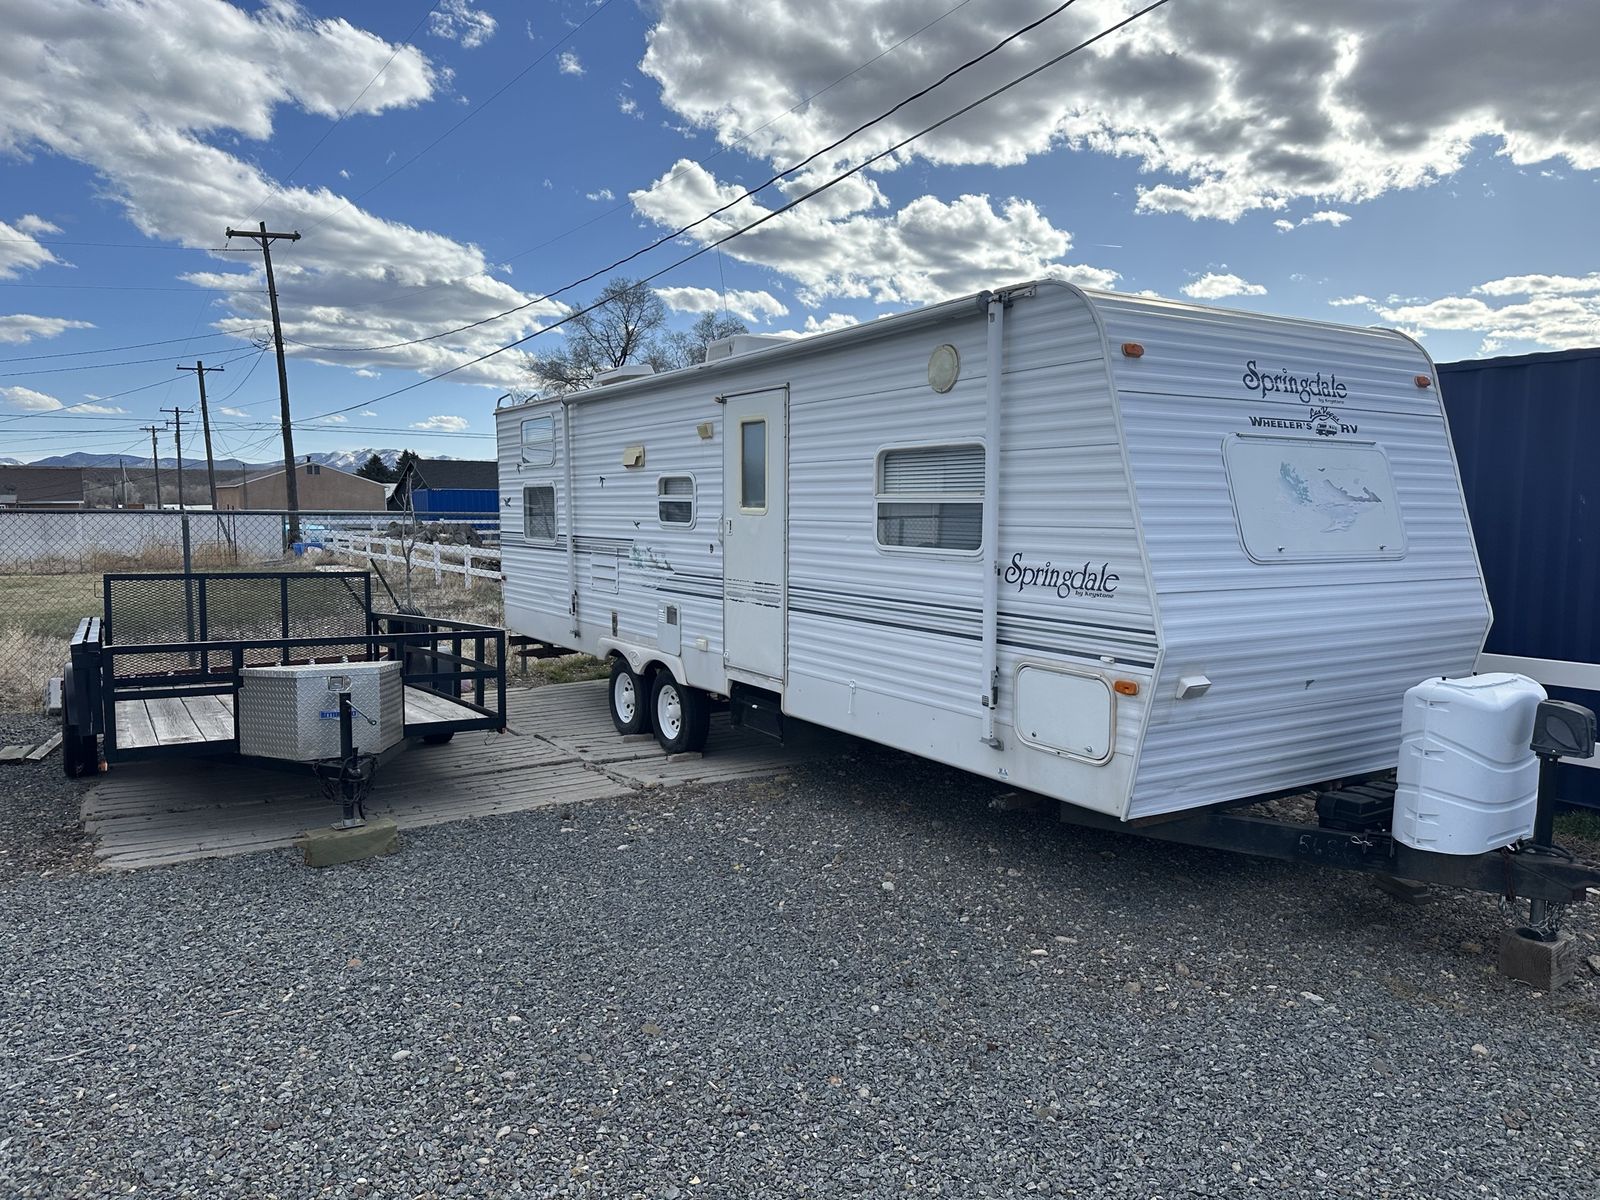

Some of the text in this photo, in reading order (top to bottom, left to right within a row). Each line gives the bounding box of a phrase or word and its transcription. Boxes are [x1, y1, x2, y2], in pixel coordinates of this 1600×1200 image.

[1242, 360, 1348, 403] Springdale
[1248, 416, 1358, 434] WHEELER'S RV
[1004, 552, 1120, 599] Springdale
